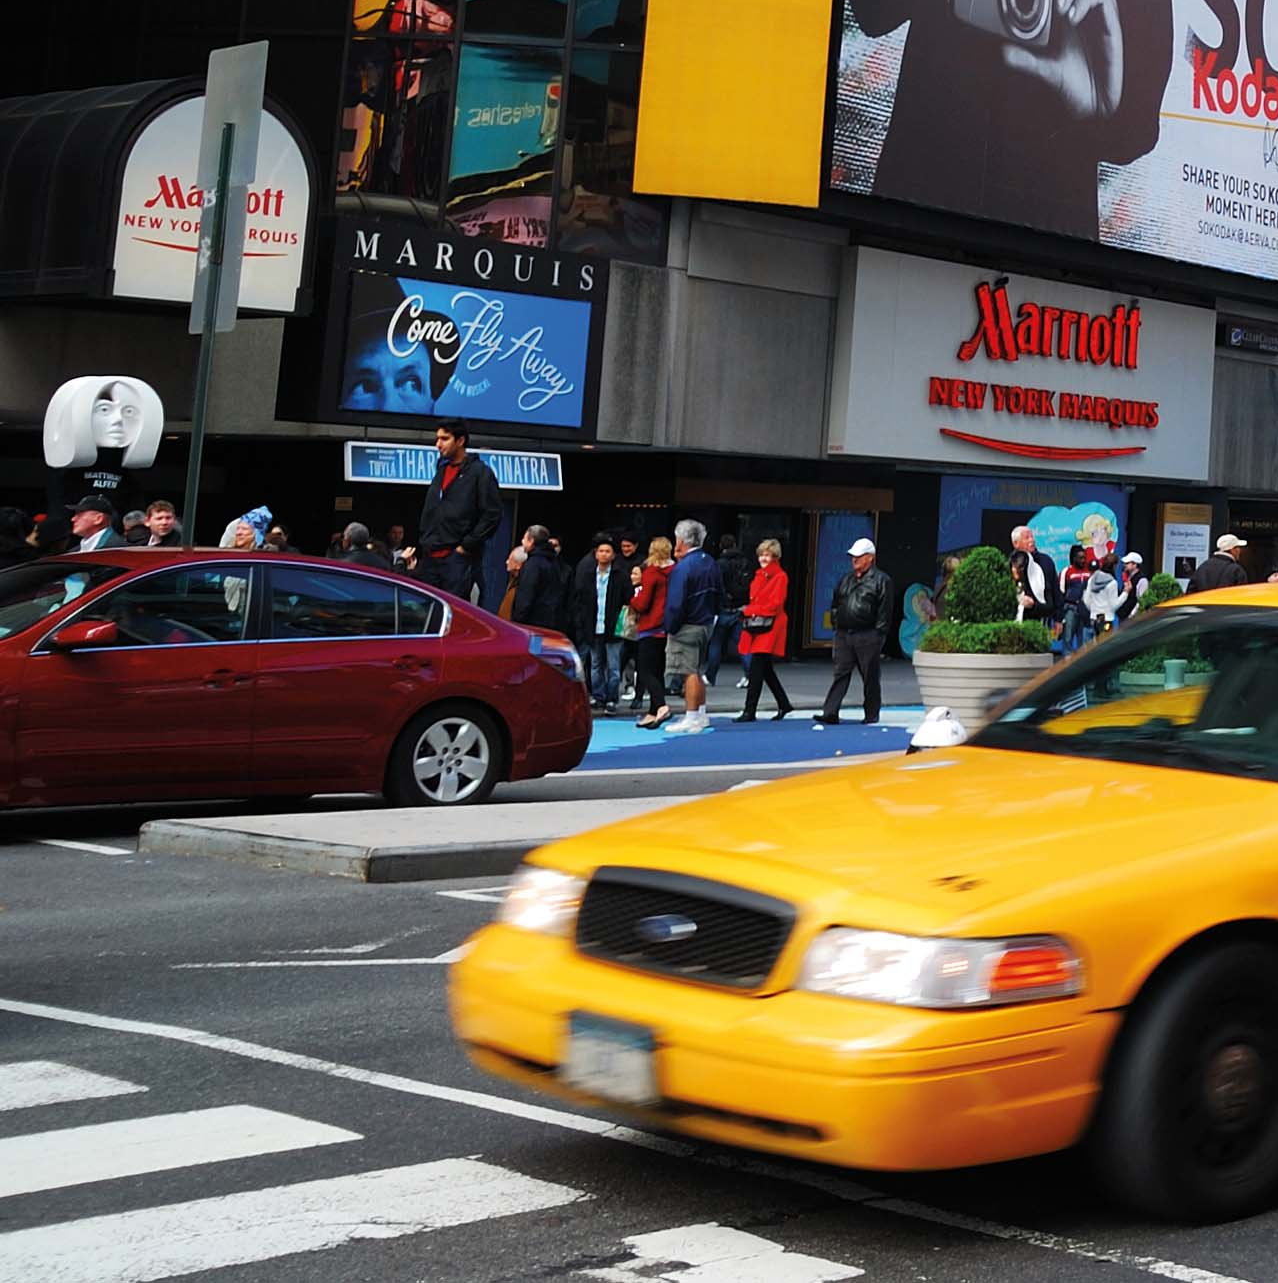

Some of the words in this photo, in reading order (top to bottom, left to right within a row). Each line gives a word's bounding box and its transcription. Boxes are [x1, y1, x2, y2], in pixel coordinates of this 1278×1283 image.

[144, 175, 285, 217] Maott
[1182, 163, 1219, 189] SHARE
[1222, 173, 1250, 198] YOUR
[1253, 183, 1266, 201] SO
[124, 214, 163, 229] NEW
[249, 228, 298, 244] RQUIS
[1206, 194, 1252, 222] MOMENT
[354, 230, 594, 291] MARQUIS
[957, 278, 1141, 369] Marriott
[387, 294, 458, 357] Come
[434, 291, 504, 370] Fly
[499, 326, 574, 411] Away
[928, 377, 987, 409] NEW
[991, 384, 1055, 417] YORK
[1059, 392, 1160, 429] MARQUIS
[397, 451, 438, 478] THAR
[489, 455, 549, 484] SINATRA
